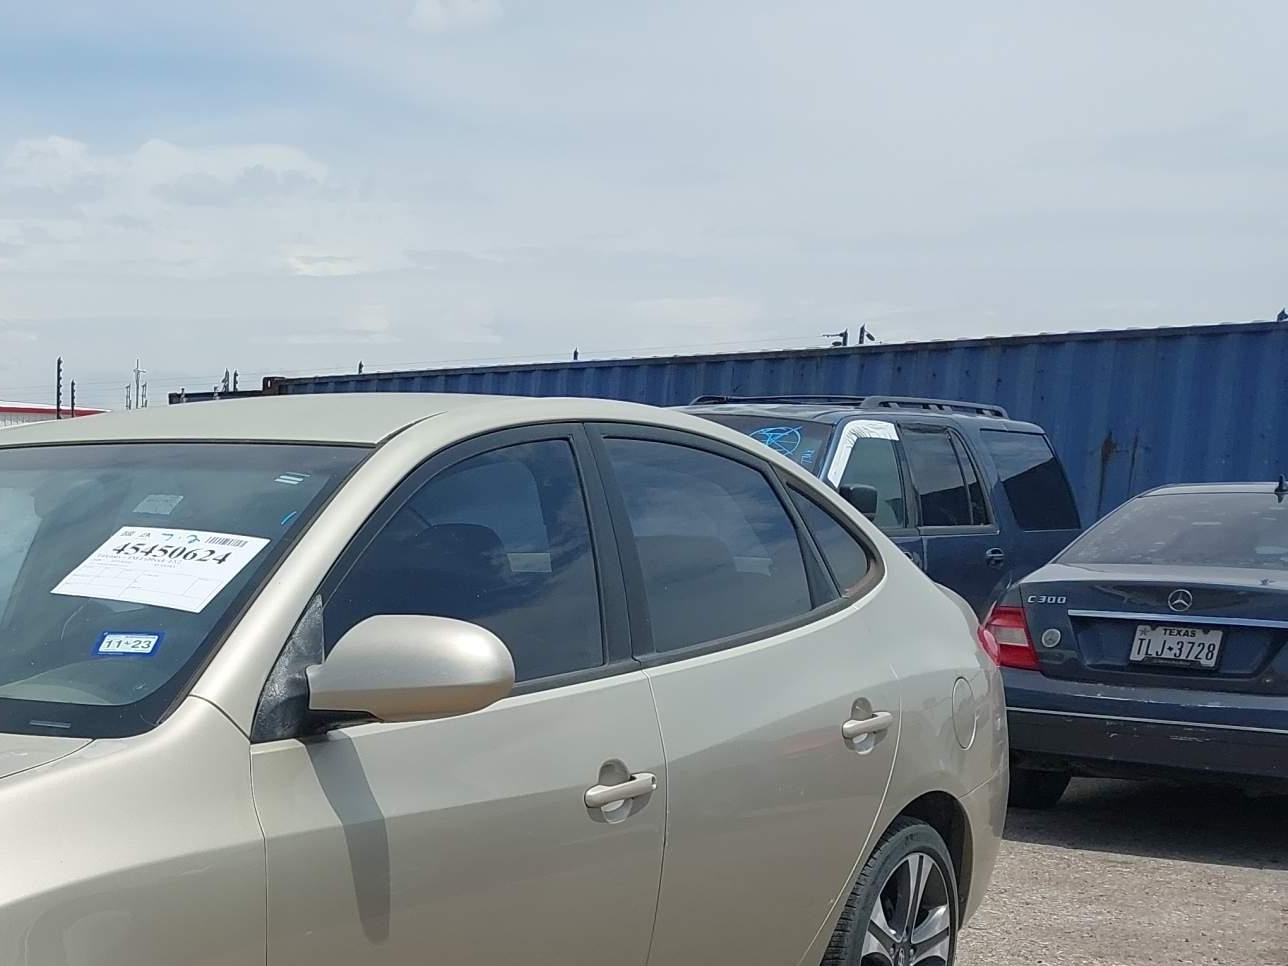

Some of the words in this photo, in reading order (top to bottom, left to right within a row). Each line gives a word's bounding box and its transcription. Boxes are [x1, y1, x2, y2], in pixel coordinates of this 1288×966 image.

[112, 542, 232, 564] 45450624
[1027, 595, 1037, 603] C
[1037, 595, 1067, 604] 300
[1163, 628, 1197, 638] TEXAS
